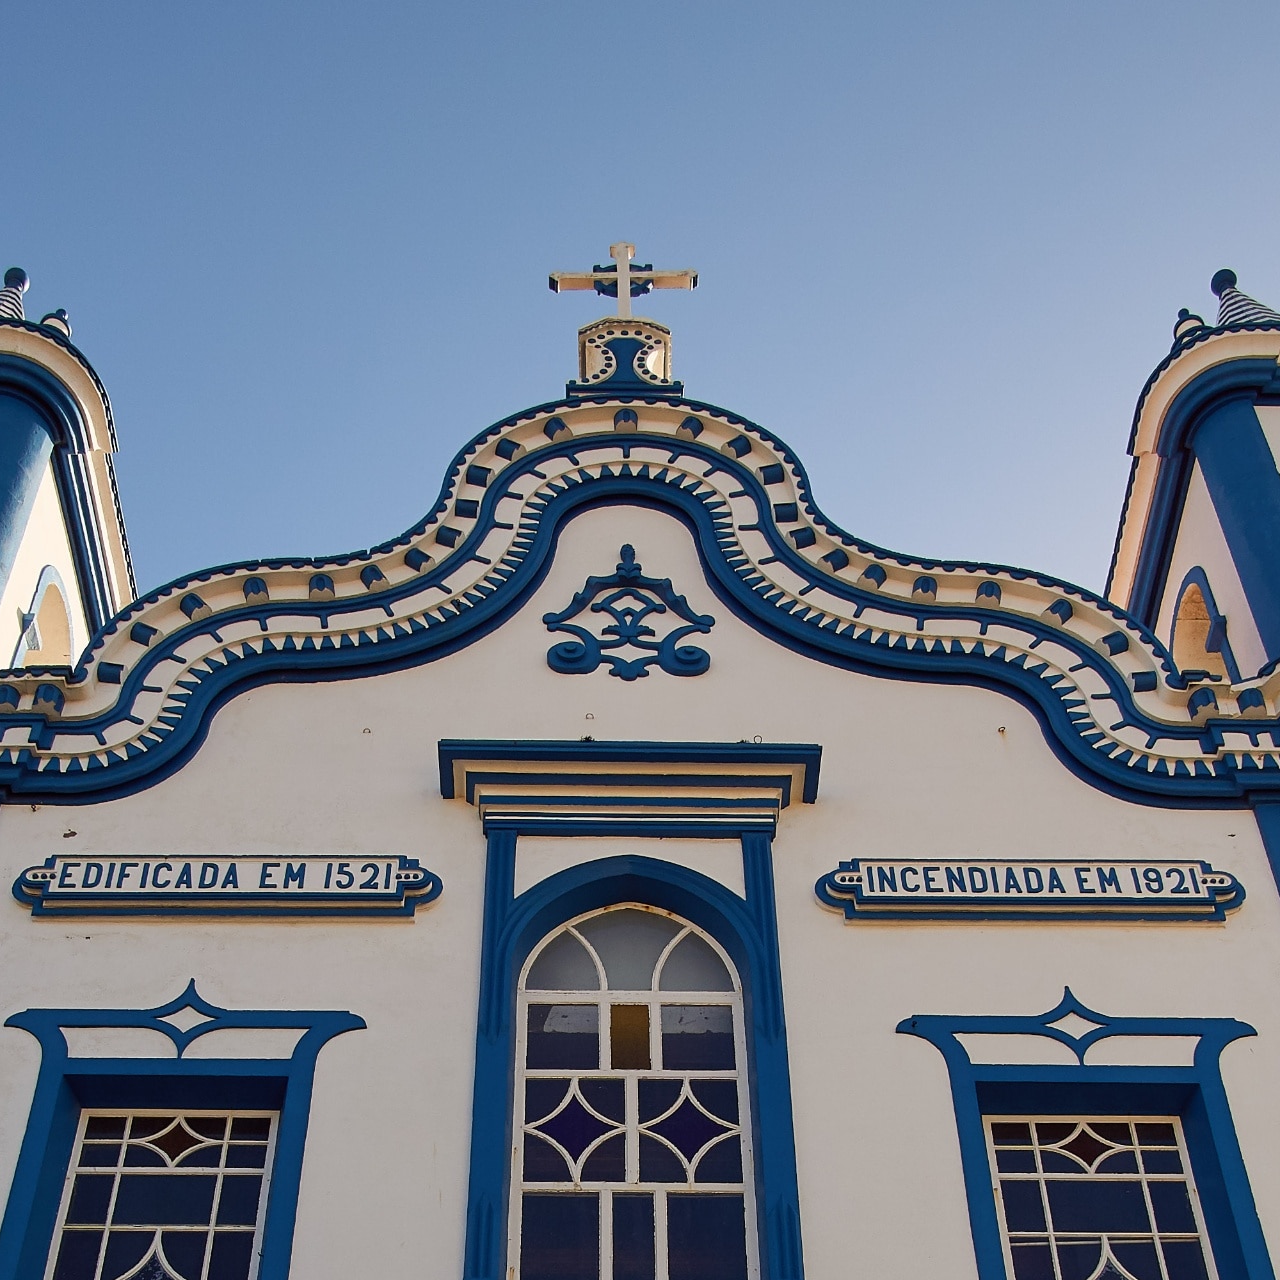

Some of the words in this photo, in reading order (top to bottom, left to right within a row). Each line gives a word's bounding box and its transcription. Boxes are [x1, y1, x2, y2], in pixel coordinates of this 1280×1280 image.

[57, 862, 239, 889] EDIFICADA
[258, 862, 307, 889] EM
[324, 862, 393, 890] 1521
[866, 866, 1067, 894] INCENDIADA
[1075, 867, 1118, 894] EM
[1131, 867, 1201, 895] 1921
